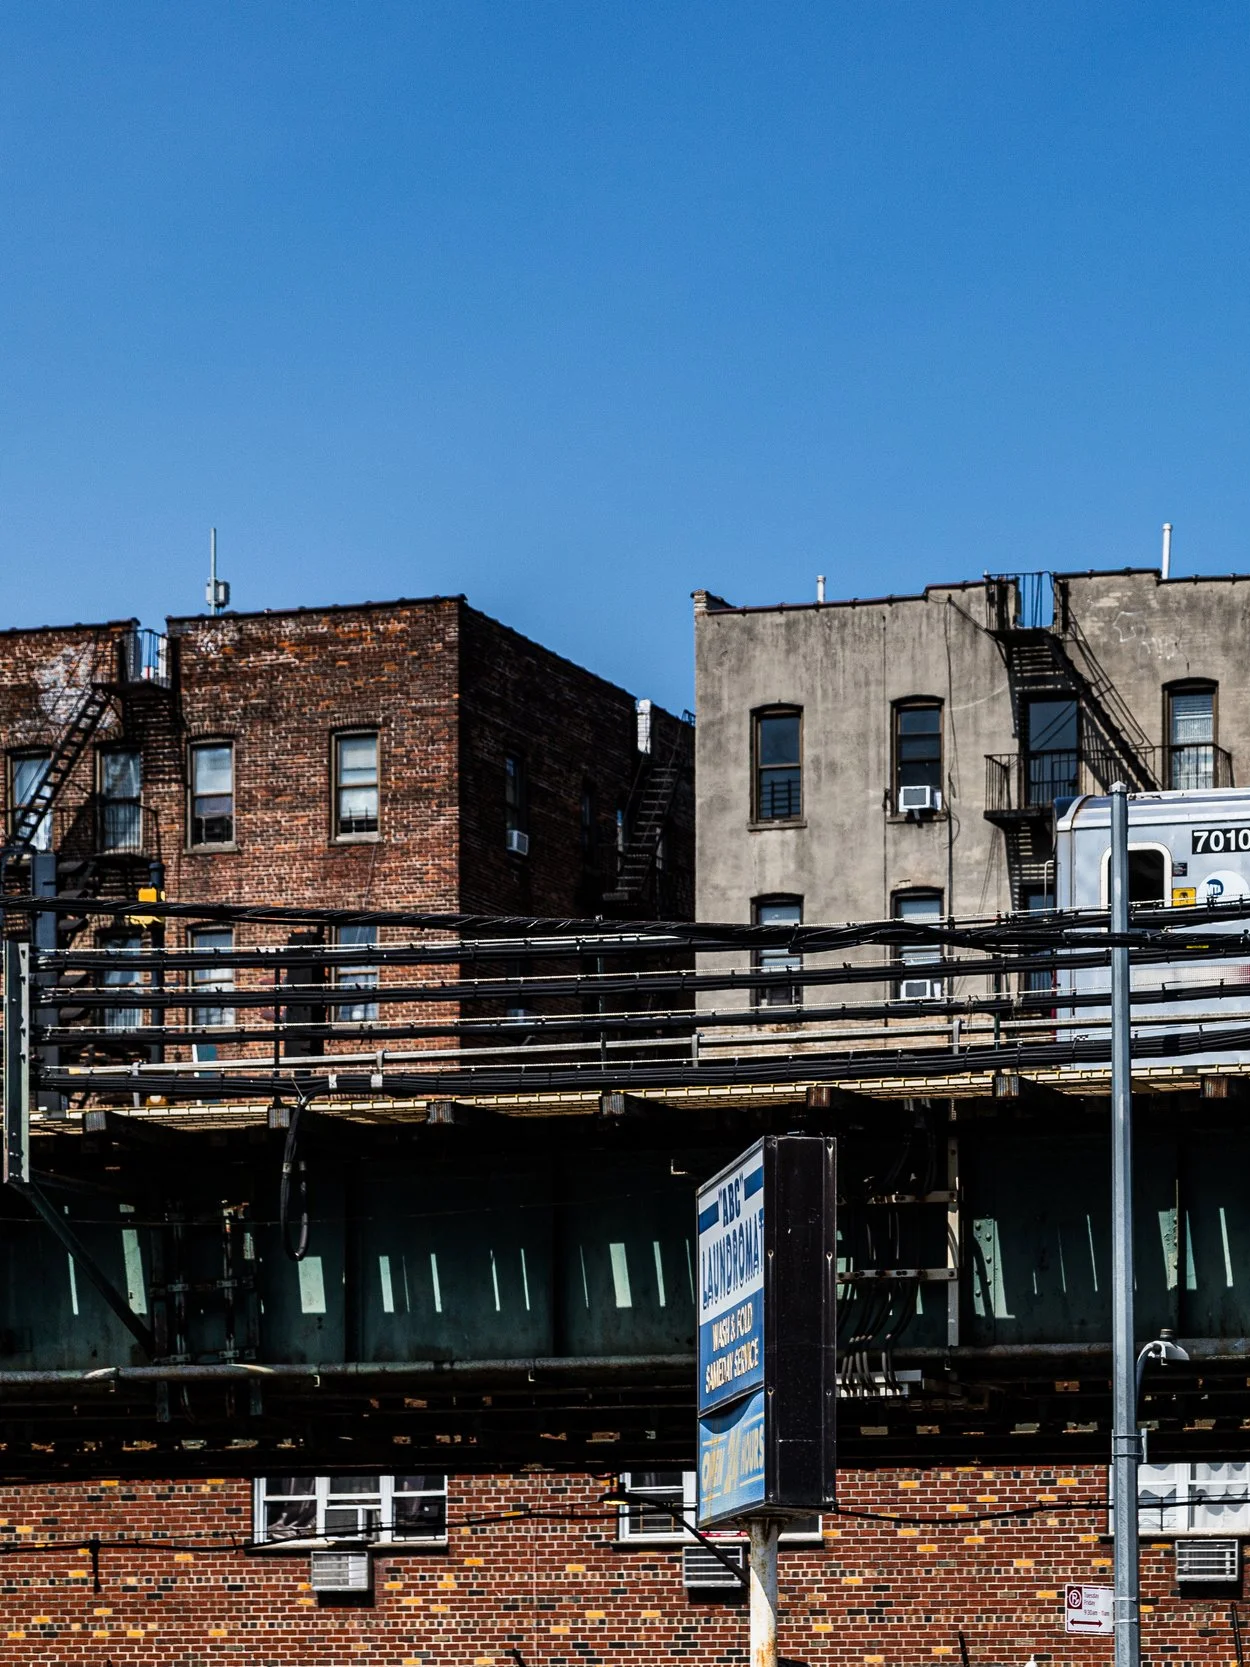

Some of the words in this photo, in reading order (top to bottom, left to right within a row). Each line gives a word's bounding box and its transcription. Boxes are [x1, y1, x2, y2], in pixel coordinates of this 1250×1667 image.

[718, 1172, 744, 1228] "ABC"
[702, 1207, 764, 1310] LAUNDROMAT
[712, 1315, 730, 1352] WASH
[737, 1302, 753, 1339] FOLD
[734, 1337, 759, 1378] SERVICE
[741, 1424, 765, 1476] HOURS
